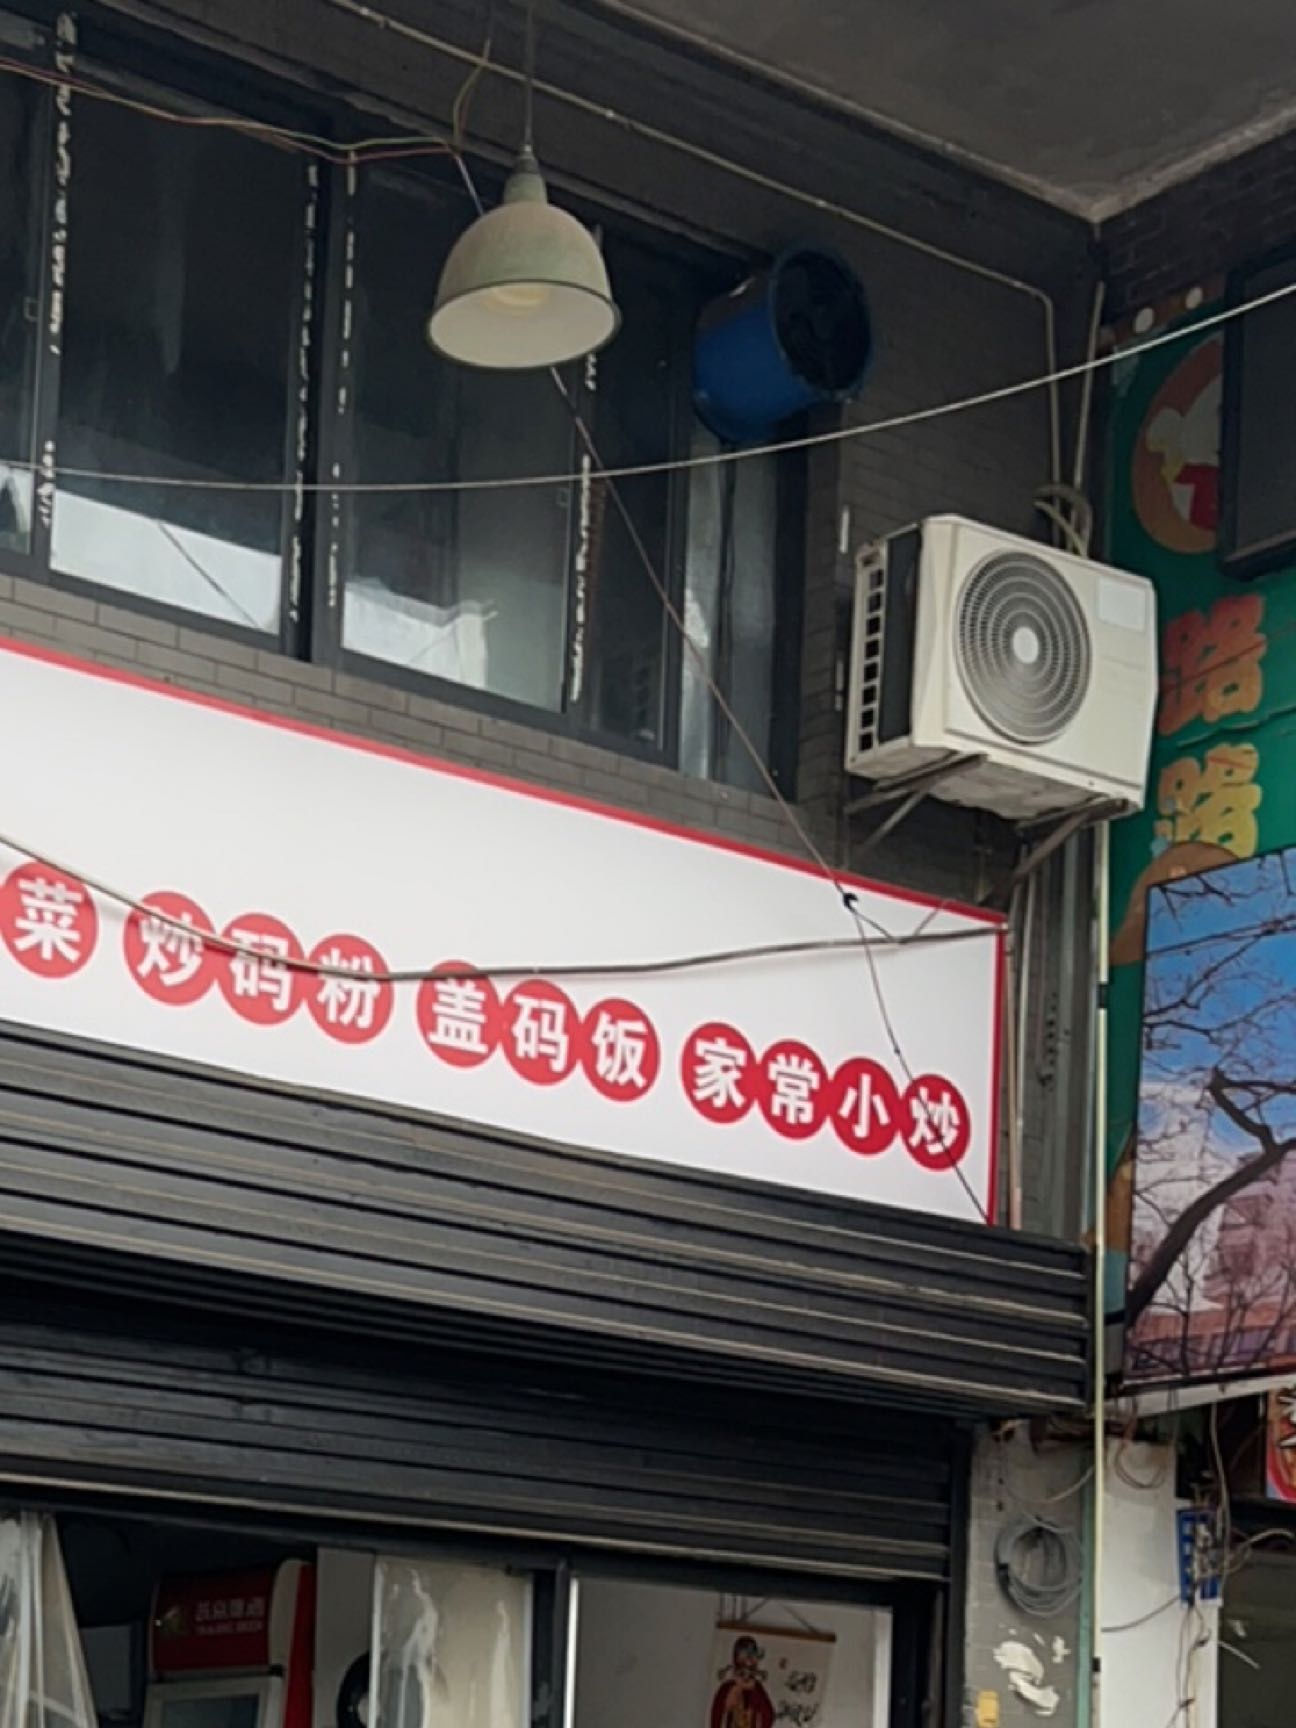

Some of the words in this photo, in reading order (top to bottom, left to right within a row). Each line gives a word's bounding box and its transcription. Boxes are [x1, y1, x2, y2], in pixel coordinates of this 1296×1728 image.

[140, 913, 381, 1027] 炒码粉
[430, 970, 648, 1091] 盖码饭
[693, 1038, 957, 1155] 家常小炒
